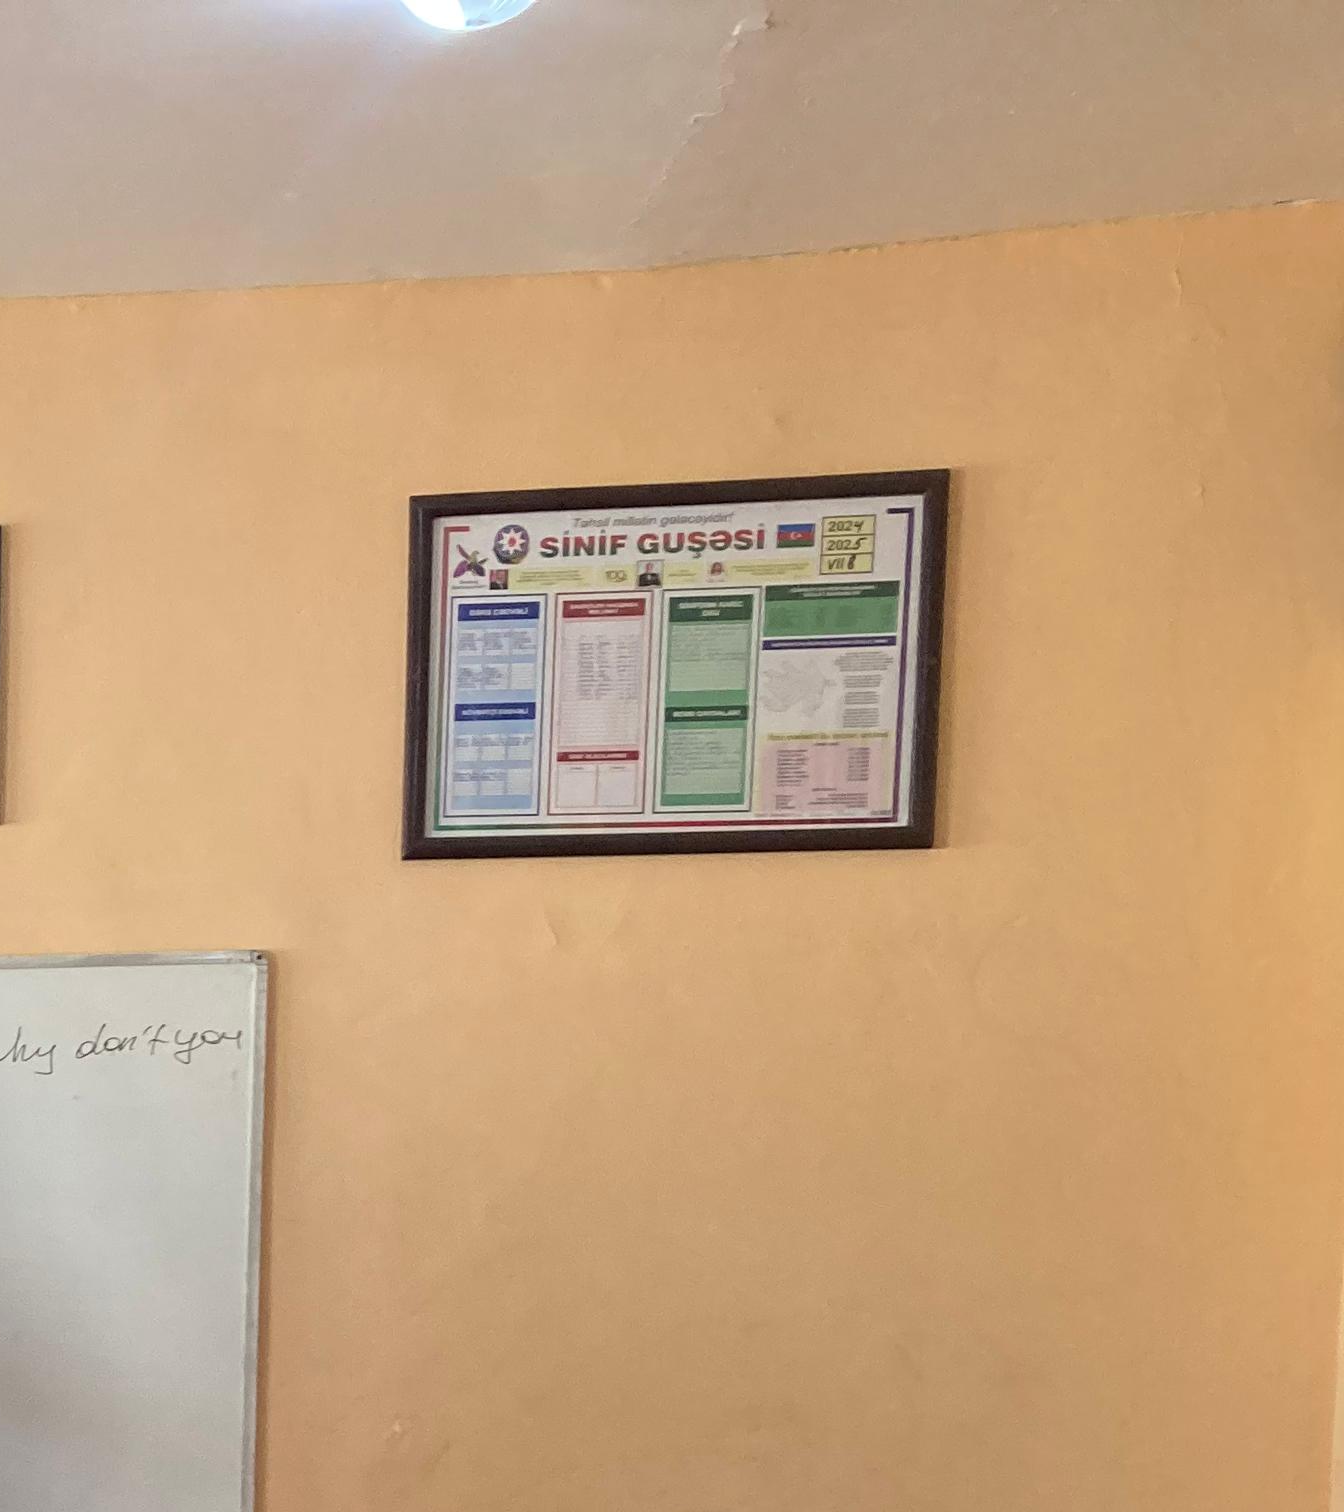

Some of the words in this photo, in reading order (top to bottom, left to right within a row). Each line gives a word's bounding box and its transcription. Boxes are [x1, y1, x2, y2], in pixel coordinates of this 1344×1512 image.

[827, 520, 865, 533] 2024
[540, 529, 628, 558] SİNİF
[637, 523, 766, 559] GUŞƏSİ
[827, 537, 868, 551] 2025
[75, 1023, 171, 1059] don't
[174, 1029, 243, 1065] you
